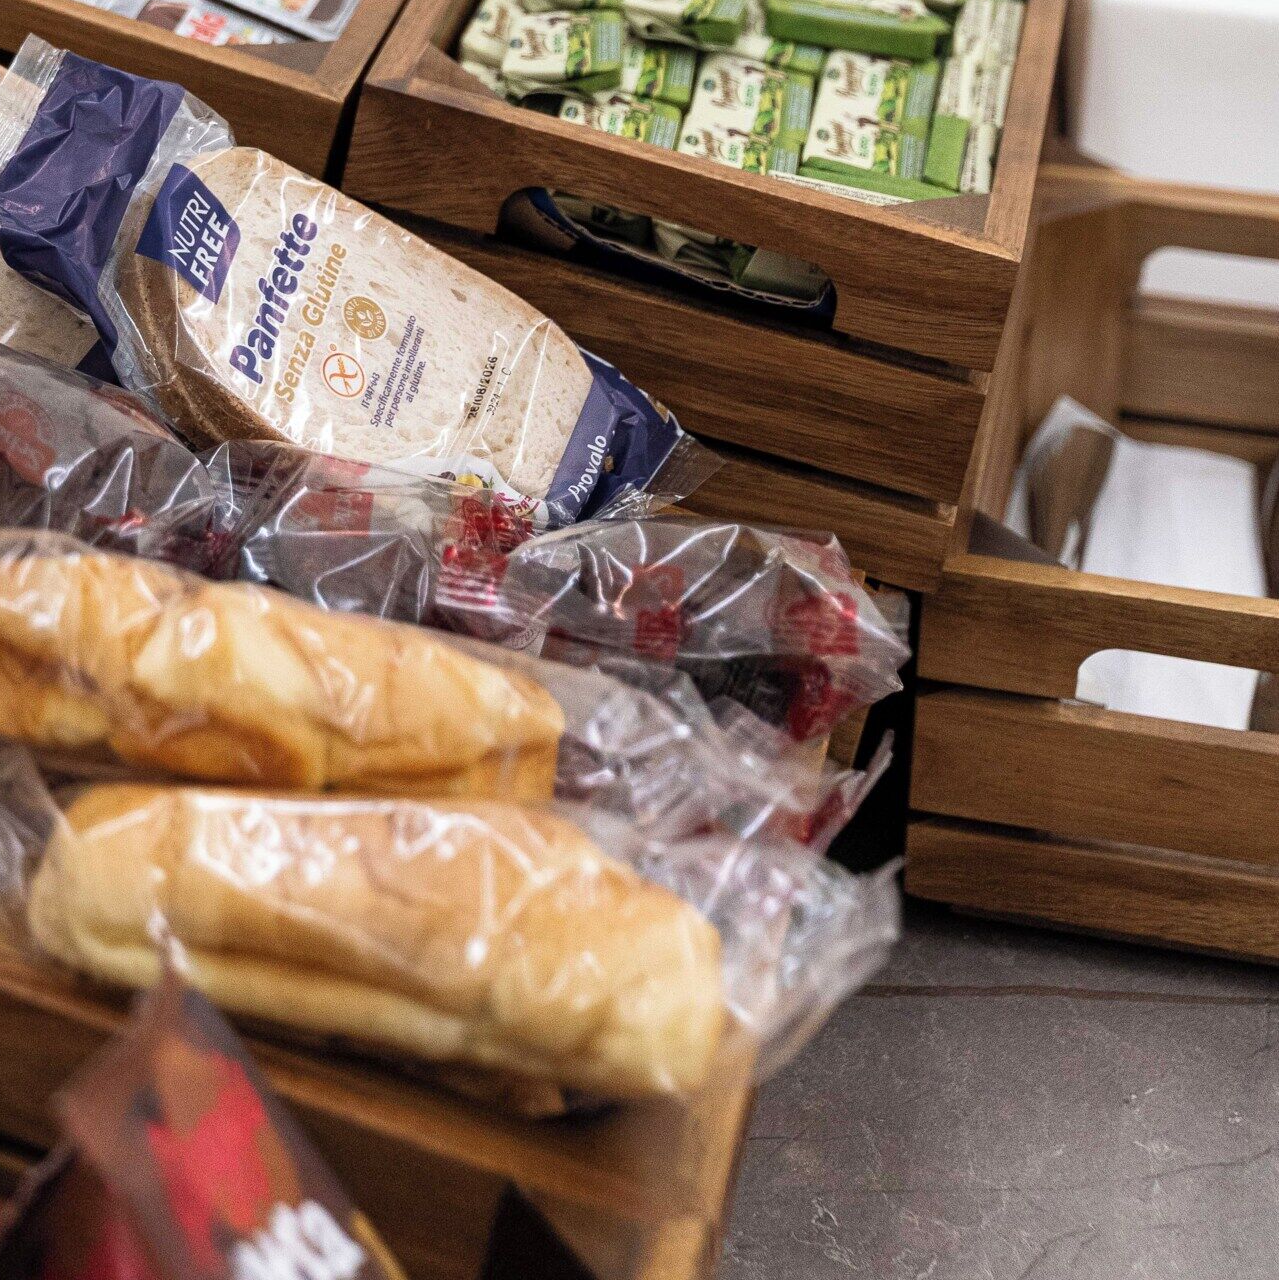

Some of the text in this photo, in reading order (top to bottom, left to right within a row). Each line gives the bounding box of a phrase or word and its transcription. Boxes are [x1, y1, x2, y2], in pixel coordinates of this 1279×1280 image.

[168, 191, 211, 267] NUTRI
[189, 213, 230, 287] FREE
[229, 213, 318, 385] Panfette
[273, 242, 348, 404] Senza Glutine
[347, 298, 360, 321] FONTE
[370, 315, 417, 428] Specificamente formulato
[384, 326, 425, 428] per persone intolleranti
[406, 360, 427, 404] al glutine.
[568, 435, 607, 503] Provalo
